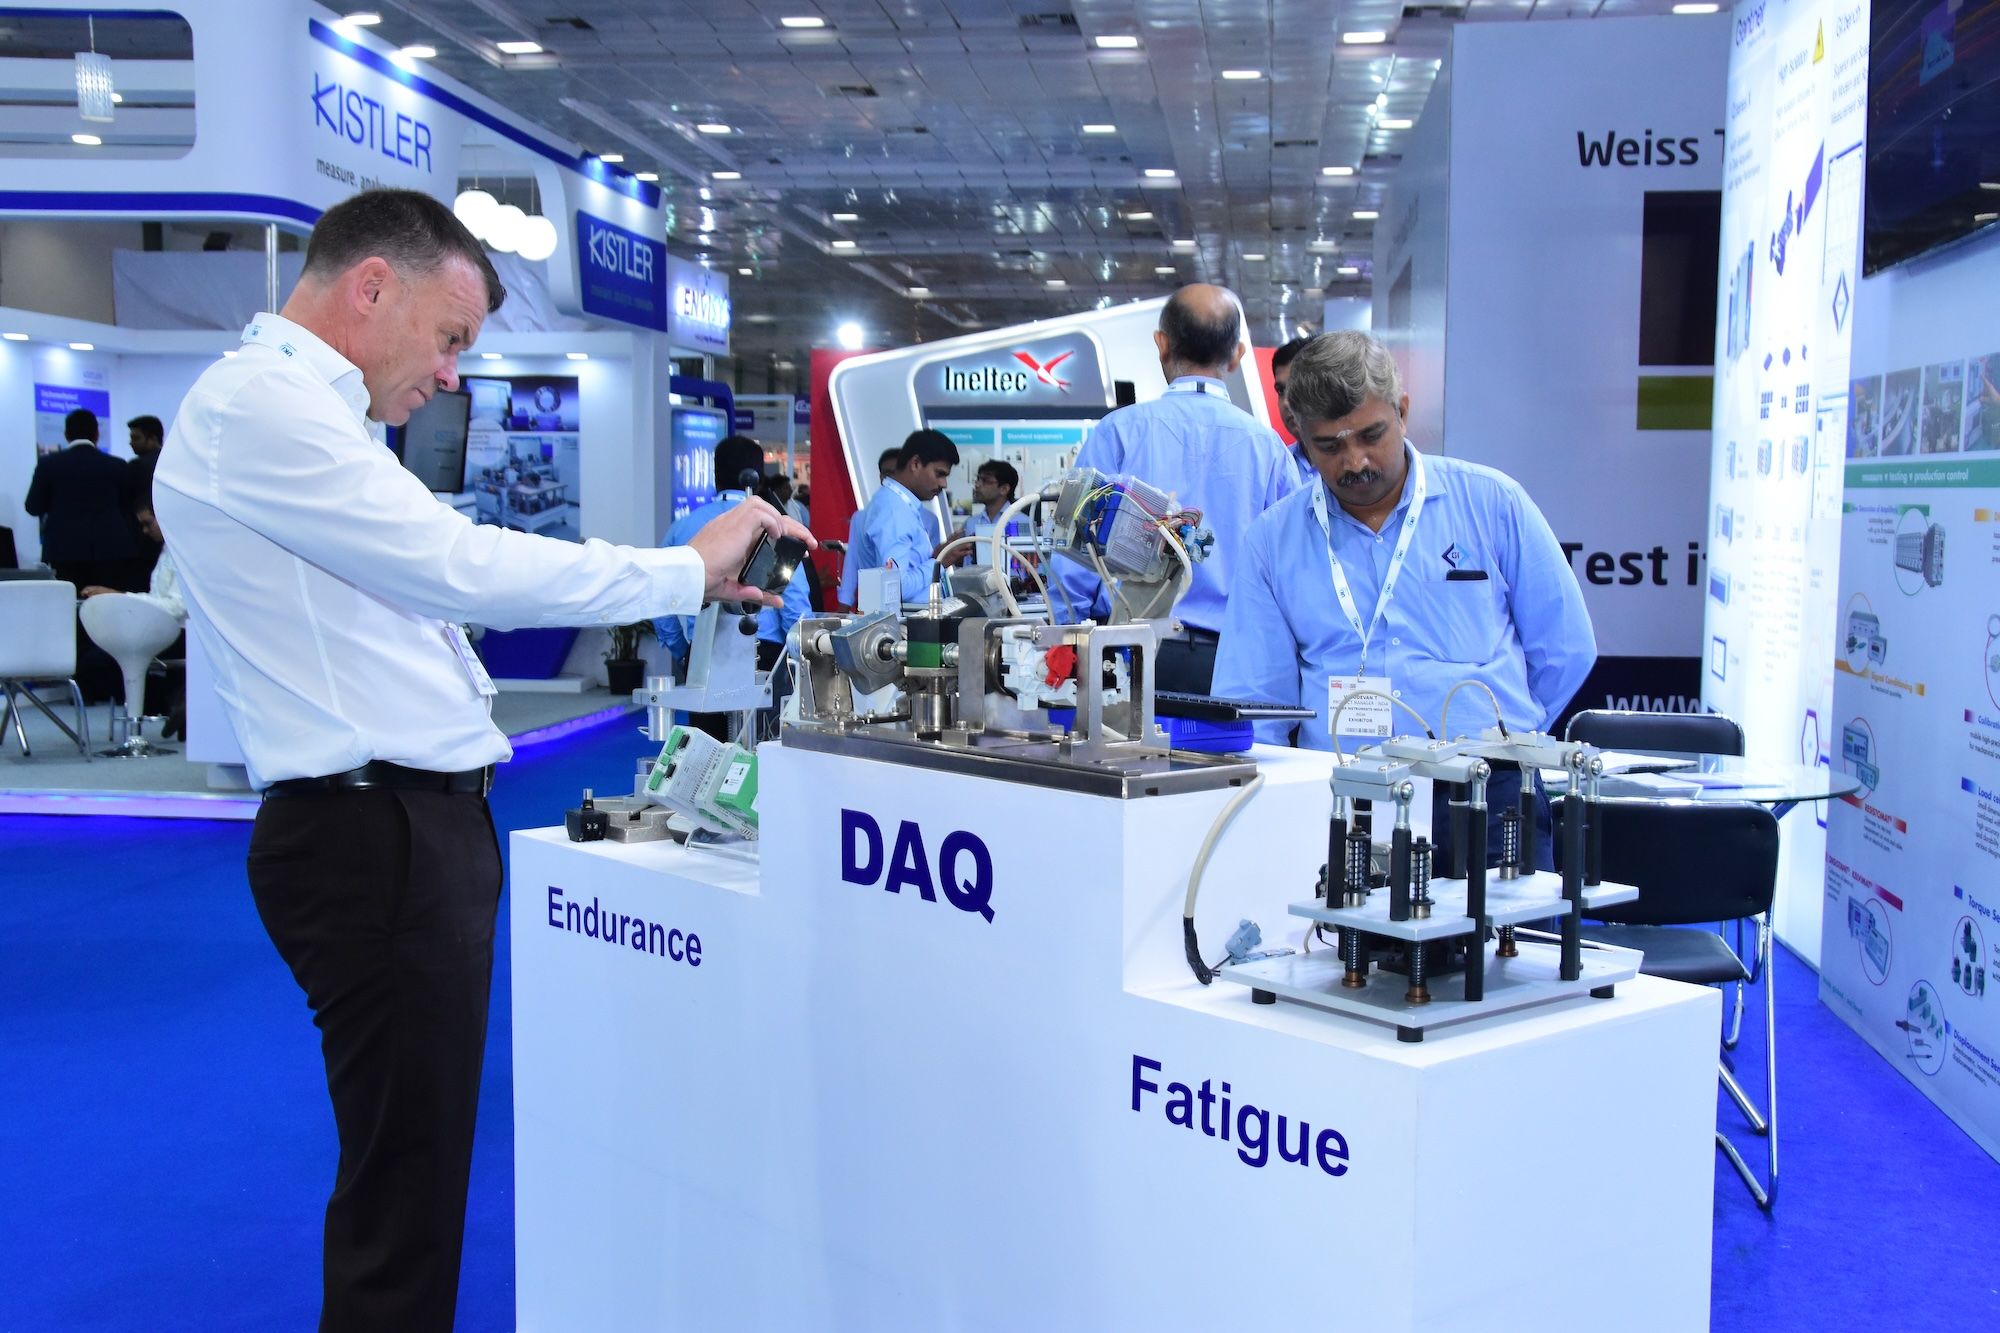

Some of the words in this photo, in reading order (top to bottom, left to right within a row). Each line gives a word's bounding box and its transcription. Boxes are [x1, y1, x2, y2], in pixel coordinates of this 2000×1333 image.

[311, 71, 432, 174] KISTLER
[1577, 128, 1699, 167] Weiss
[588, 223, 653, 284] KISTLER
[945, 365, 1027, 392] Ineltec
[1914, 469, 1946, 484] production
[1947, 467, 1969, 481] control
[1978, 785, 1992, 801] Load
[841, 808, 994, 924] DAQ
[1968, 894, 1990, 918] Torque
[548, 885, 703, 967] Endurance
[1953, 1029, 1990, 1066] Displacement
[1131, 1054, 1349, 1177] Fatigue
